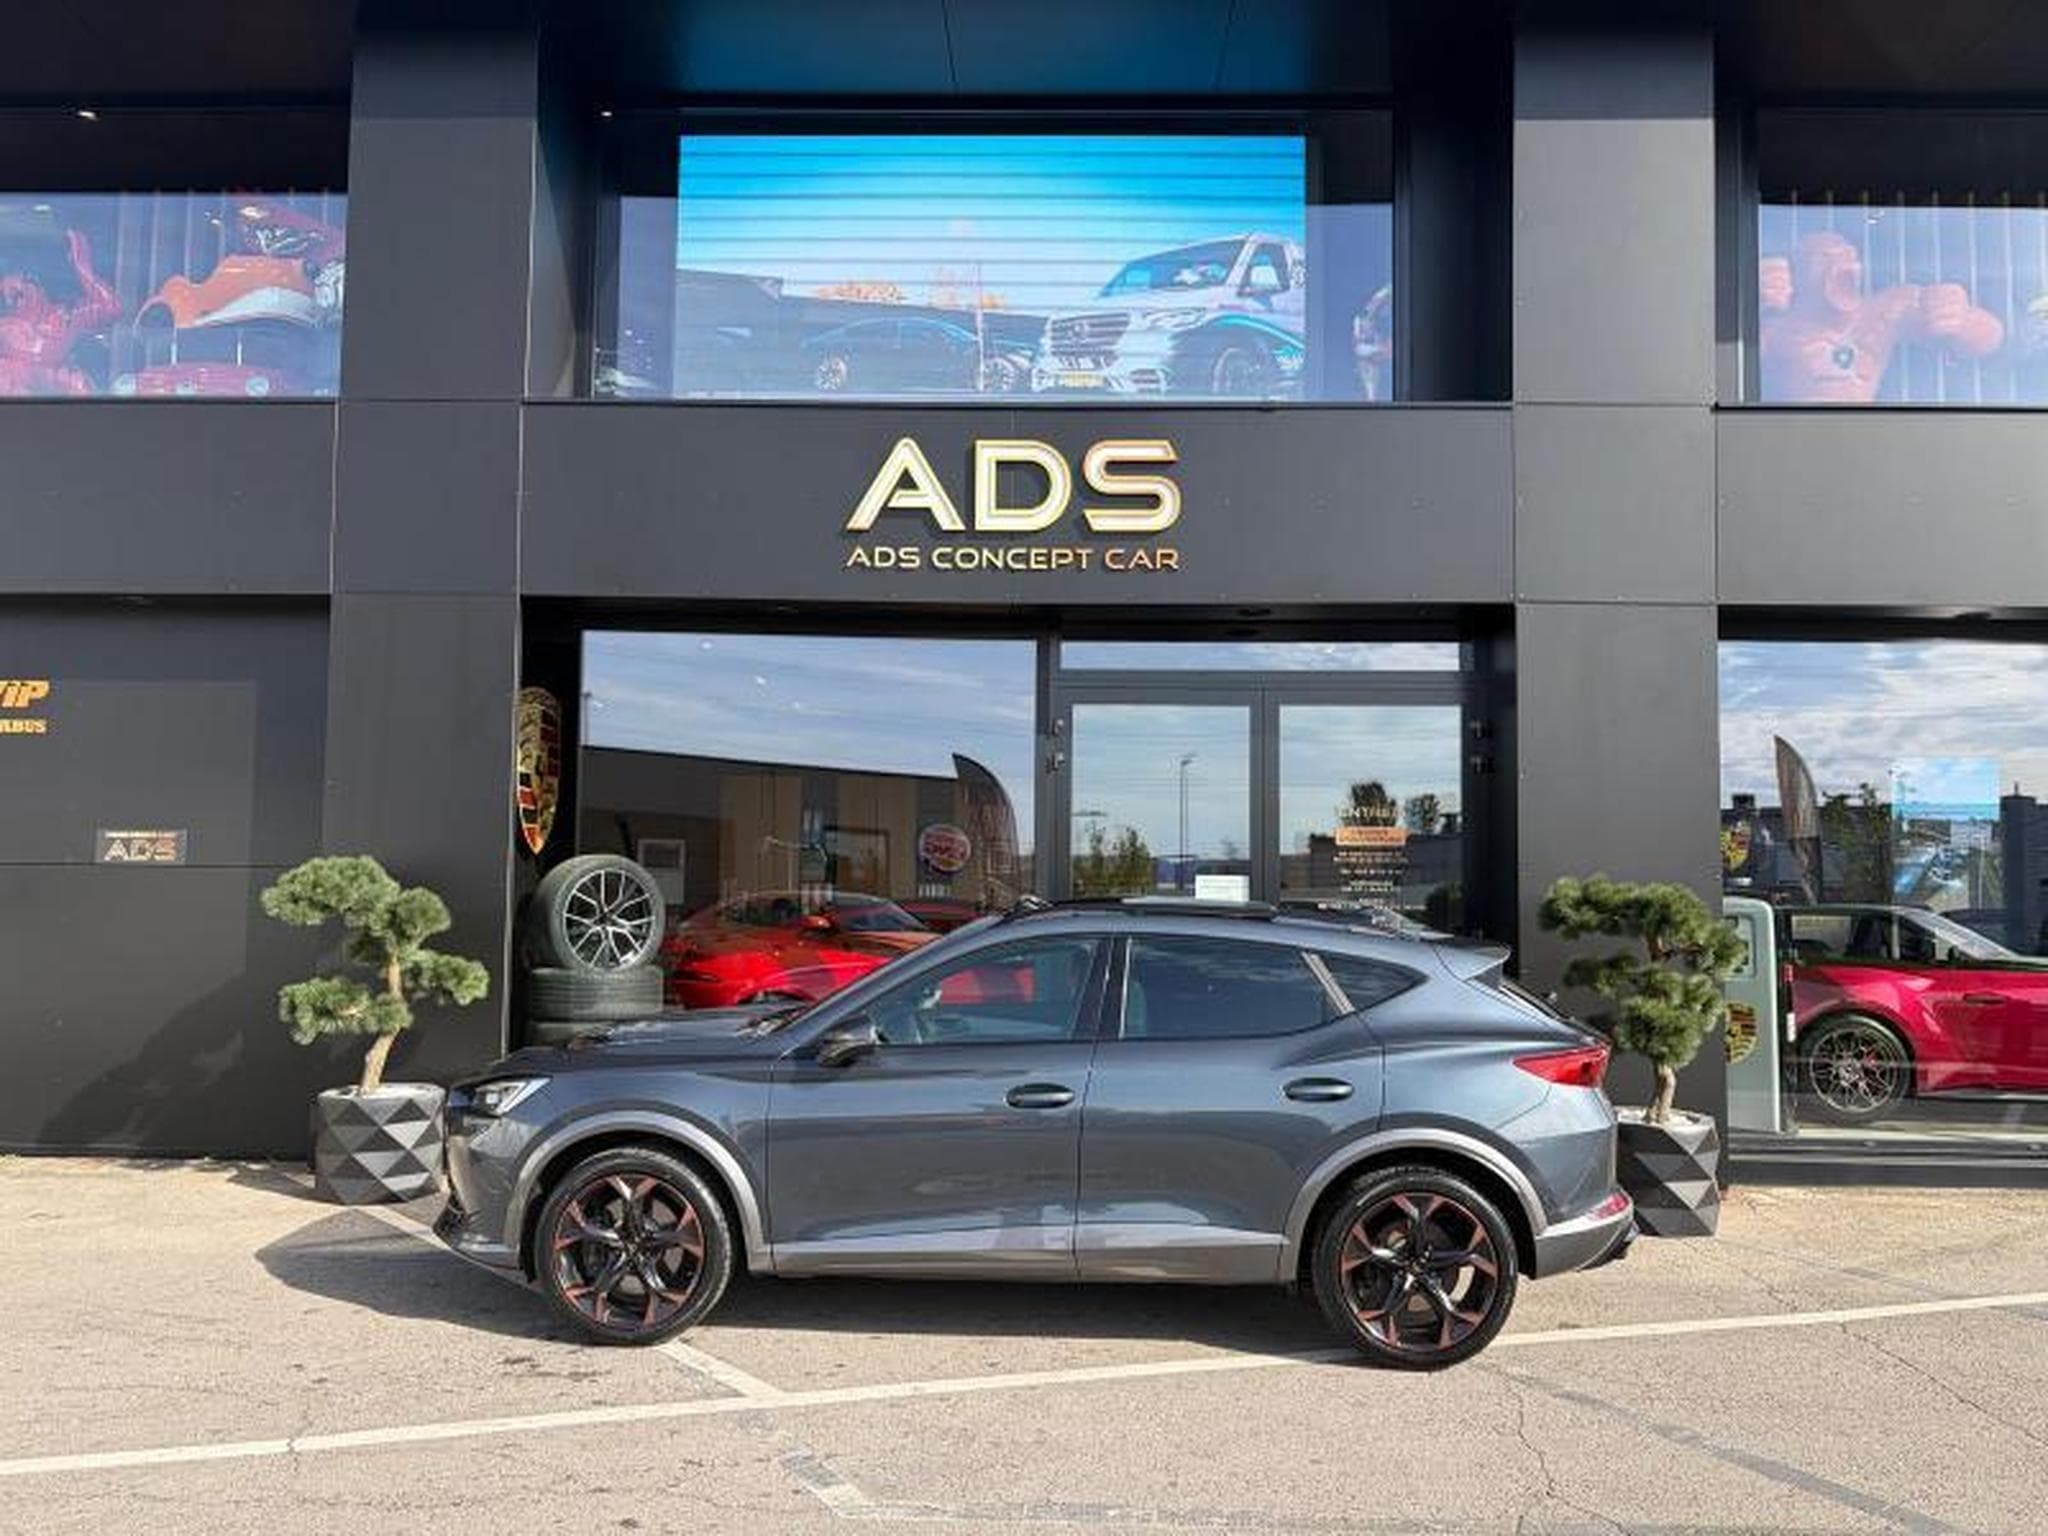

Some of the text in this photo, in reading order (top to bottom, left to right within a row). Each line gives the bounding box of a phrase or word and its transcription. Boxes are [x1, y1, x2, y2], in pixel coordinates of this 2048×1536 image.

[846, 437, 1181, 531] ADS
[847, 546, 1179, 569] ADS CONCEPT CAR
[104, 839, 177, 861] ADS
